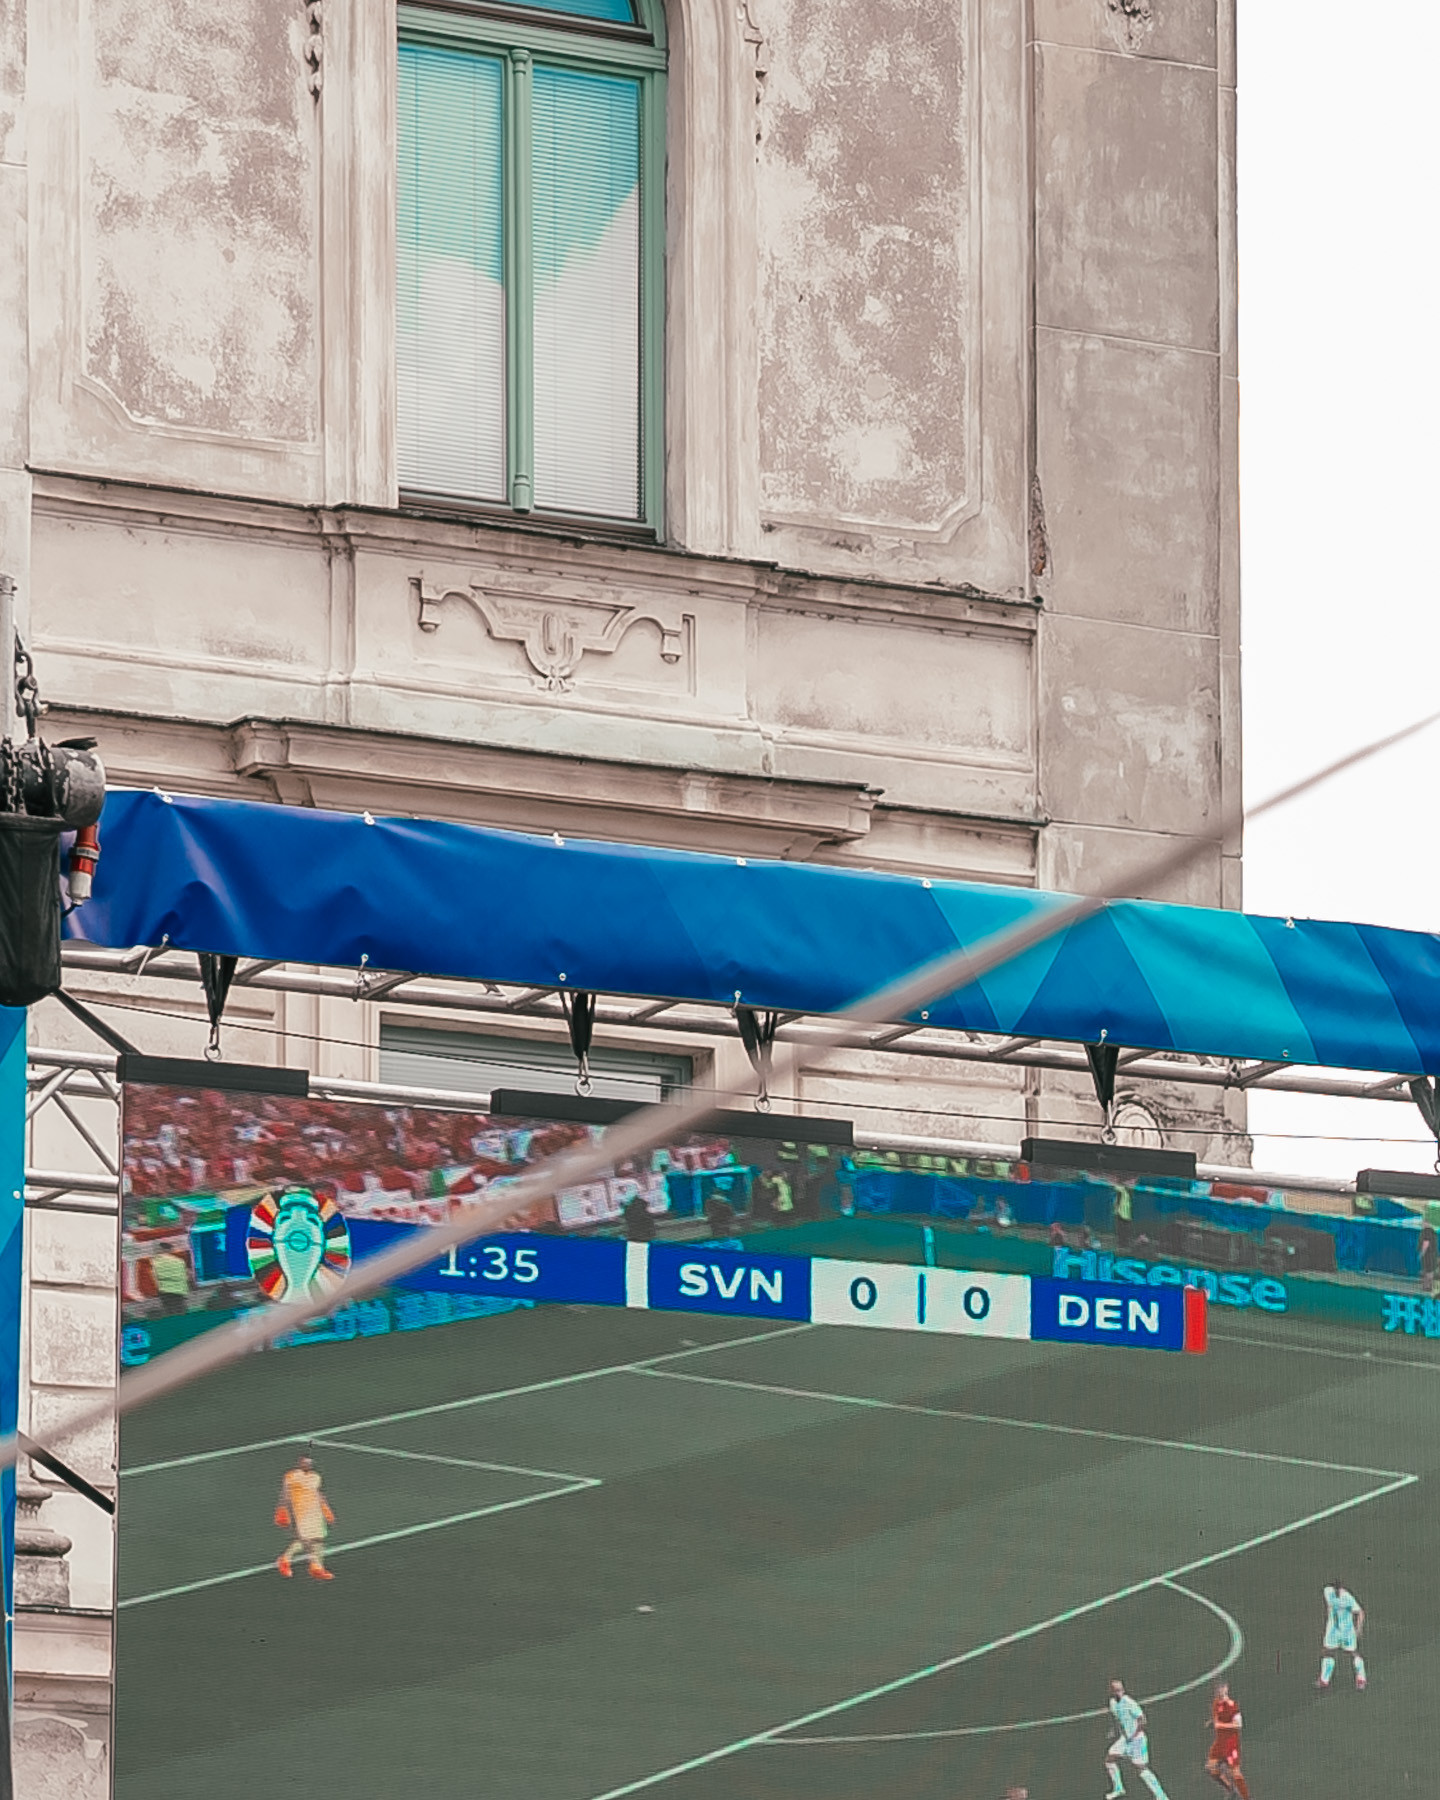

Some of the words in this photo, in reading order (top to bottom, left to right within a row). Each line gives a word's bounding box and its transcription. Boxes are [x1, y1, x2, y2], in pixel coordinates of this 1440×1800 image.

[679, 1263, 782, 1304] SVN
[849, 1277, 878, 1311] 0
[963, 1286, 991, 1320] 0
[1053, 1245, 1288, 1313] Hisense
[1058, 1294, 1160, 1334] DEN
